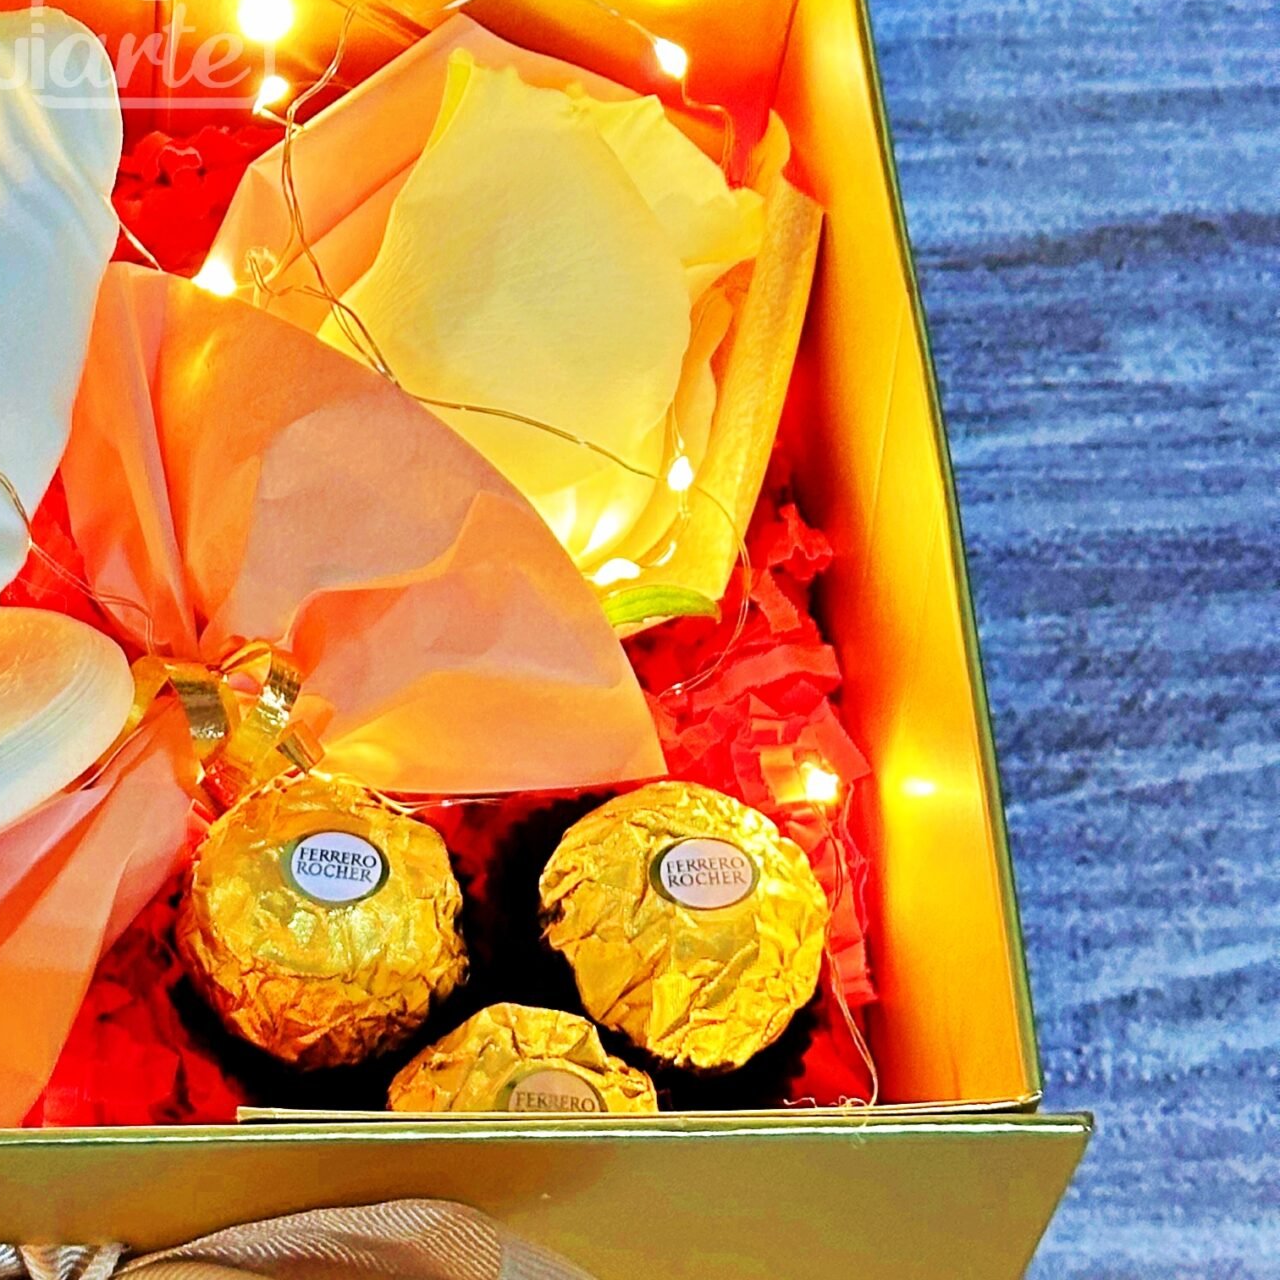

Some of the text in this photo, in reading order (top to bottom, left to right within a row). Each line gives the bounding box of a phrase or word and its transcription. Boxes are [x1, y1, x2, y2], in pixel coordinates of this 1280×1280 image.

[299, 846, 377, 868] FERRERO
[666, 856, 745, 873] FERRERO
[296, 860, 373, 883] ROCHER
[667, 870, 747, 888] ROCHER
[515, 1091, 595, 1112] FERRERO
